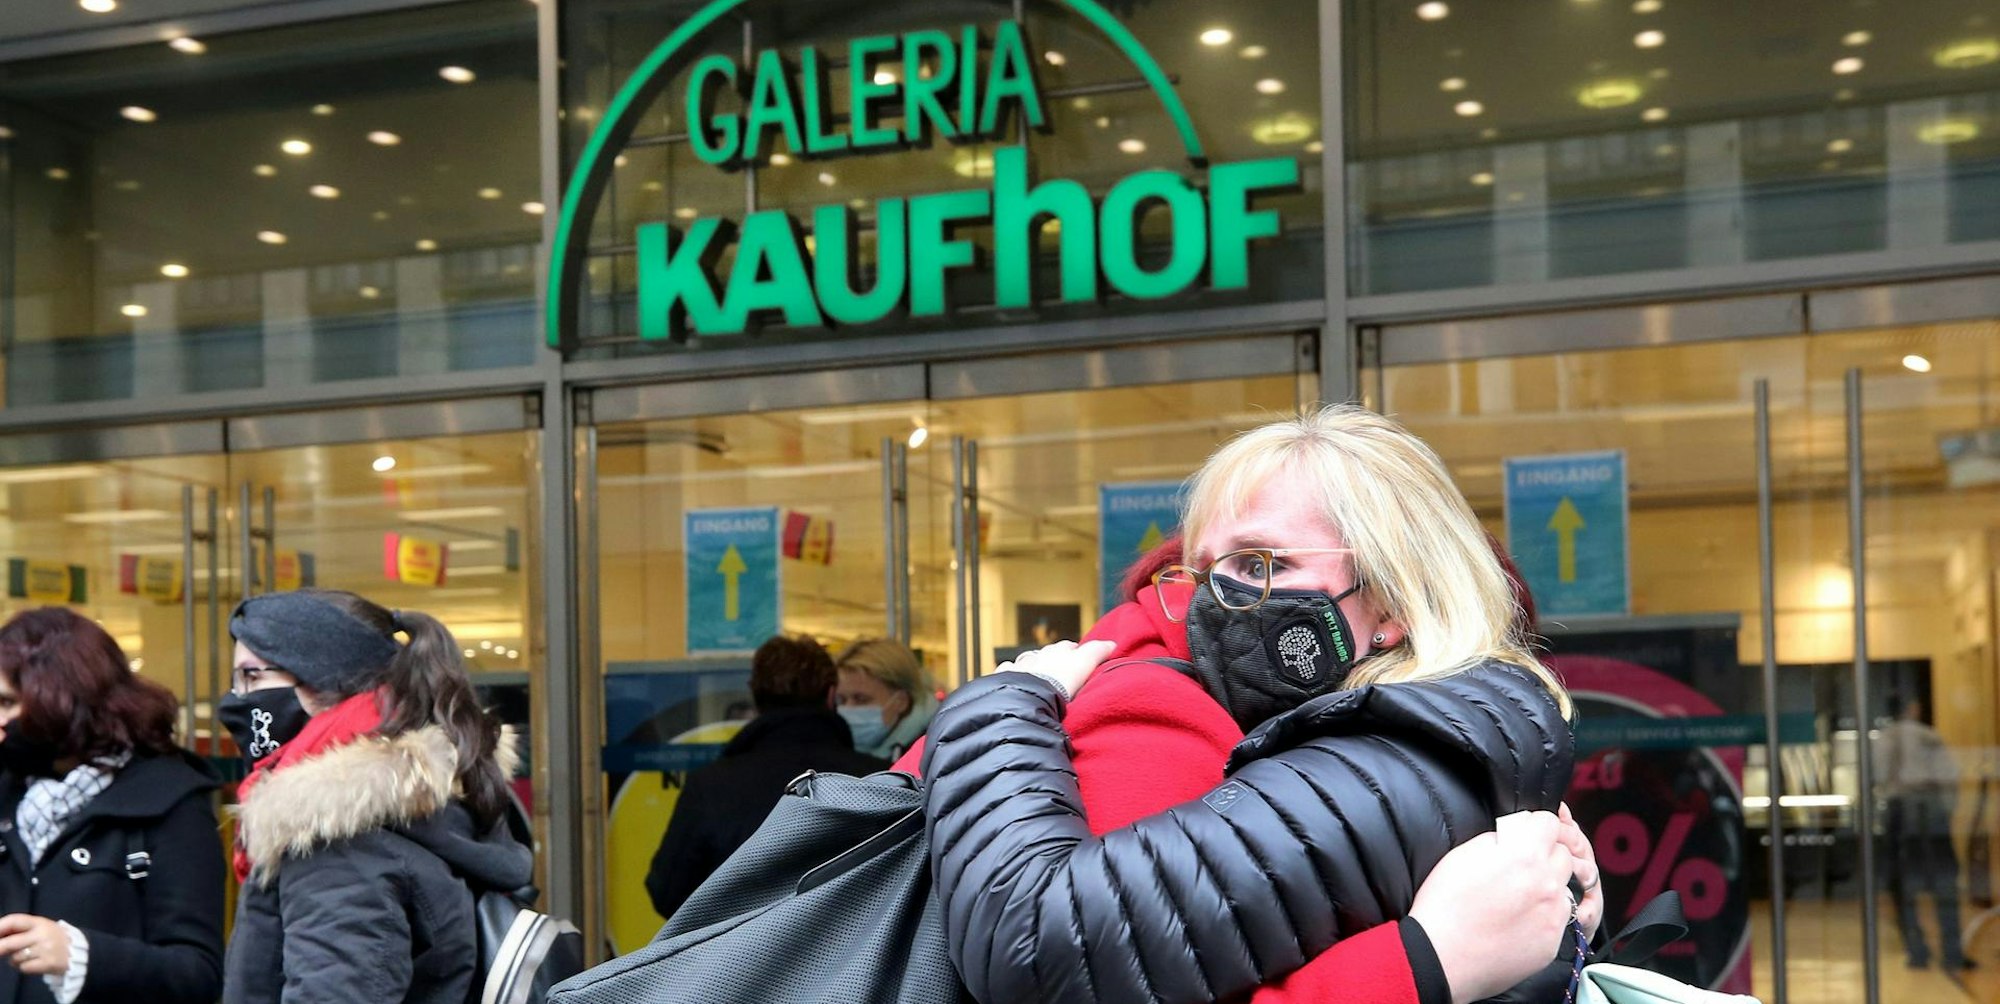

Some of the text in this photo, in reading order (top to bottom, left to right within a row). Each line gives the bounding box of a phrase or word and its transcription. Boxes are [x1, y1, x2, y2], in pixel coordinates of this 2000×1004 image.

[687, 20, 1043, 164] GALERIA
[1516, 464, 1613, 487] EINGANG
[693, 516, 769, 534] EINGANG
[1324, 611, 1349, 662] SYLT BRANDS
